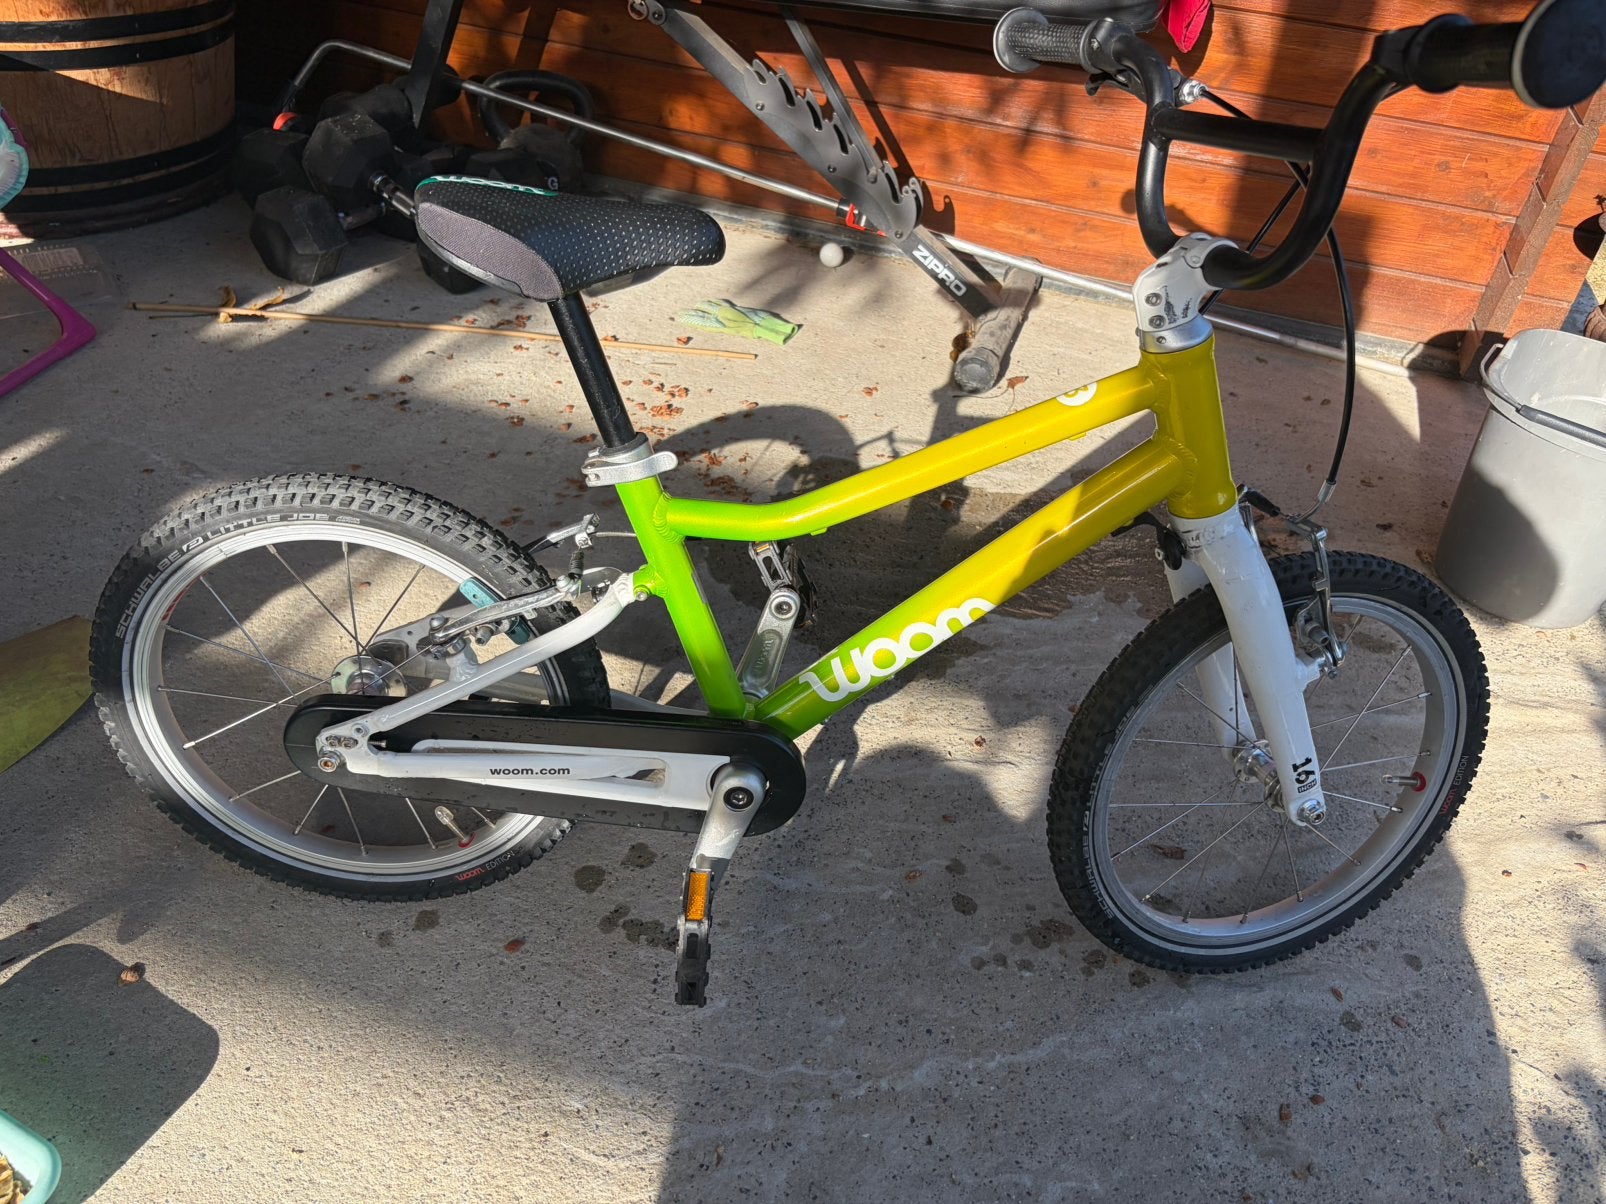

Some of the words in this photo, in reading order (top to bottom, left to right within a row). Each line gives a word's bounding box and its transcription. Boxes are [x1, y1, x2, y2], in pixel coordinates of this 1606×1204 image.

[912, 244, 967, 296] ZIPRO
[115, 549, 182, 639] SCHWALBE
[206, 514, 281, 540] LITTLE
[287, 513, 329, 521] JOE
[798, 597, 998, 702] woom
[489, 767, 571, 776] woom.com
[1292, 756, 1316, 785] 16
[1298, 778, 1317, 793] INCH
[1453, 755, 1469, 786] EDITION
[454, 867, 486, 881] woom
